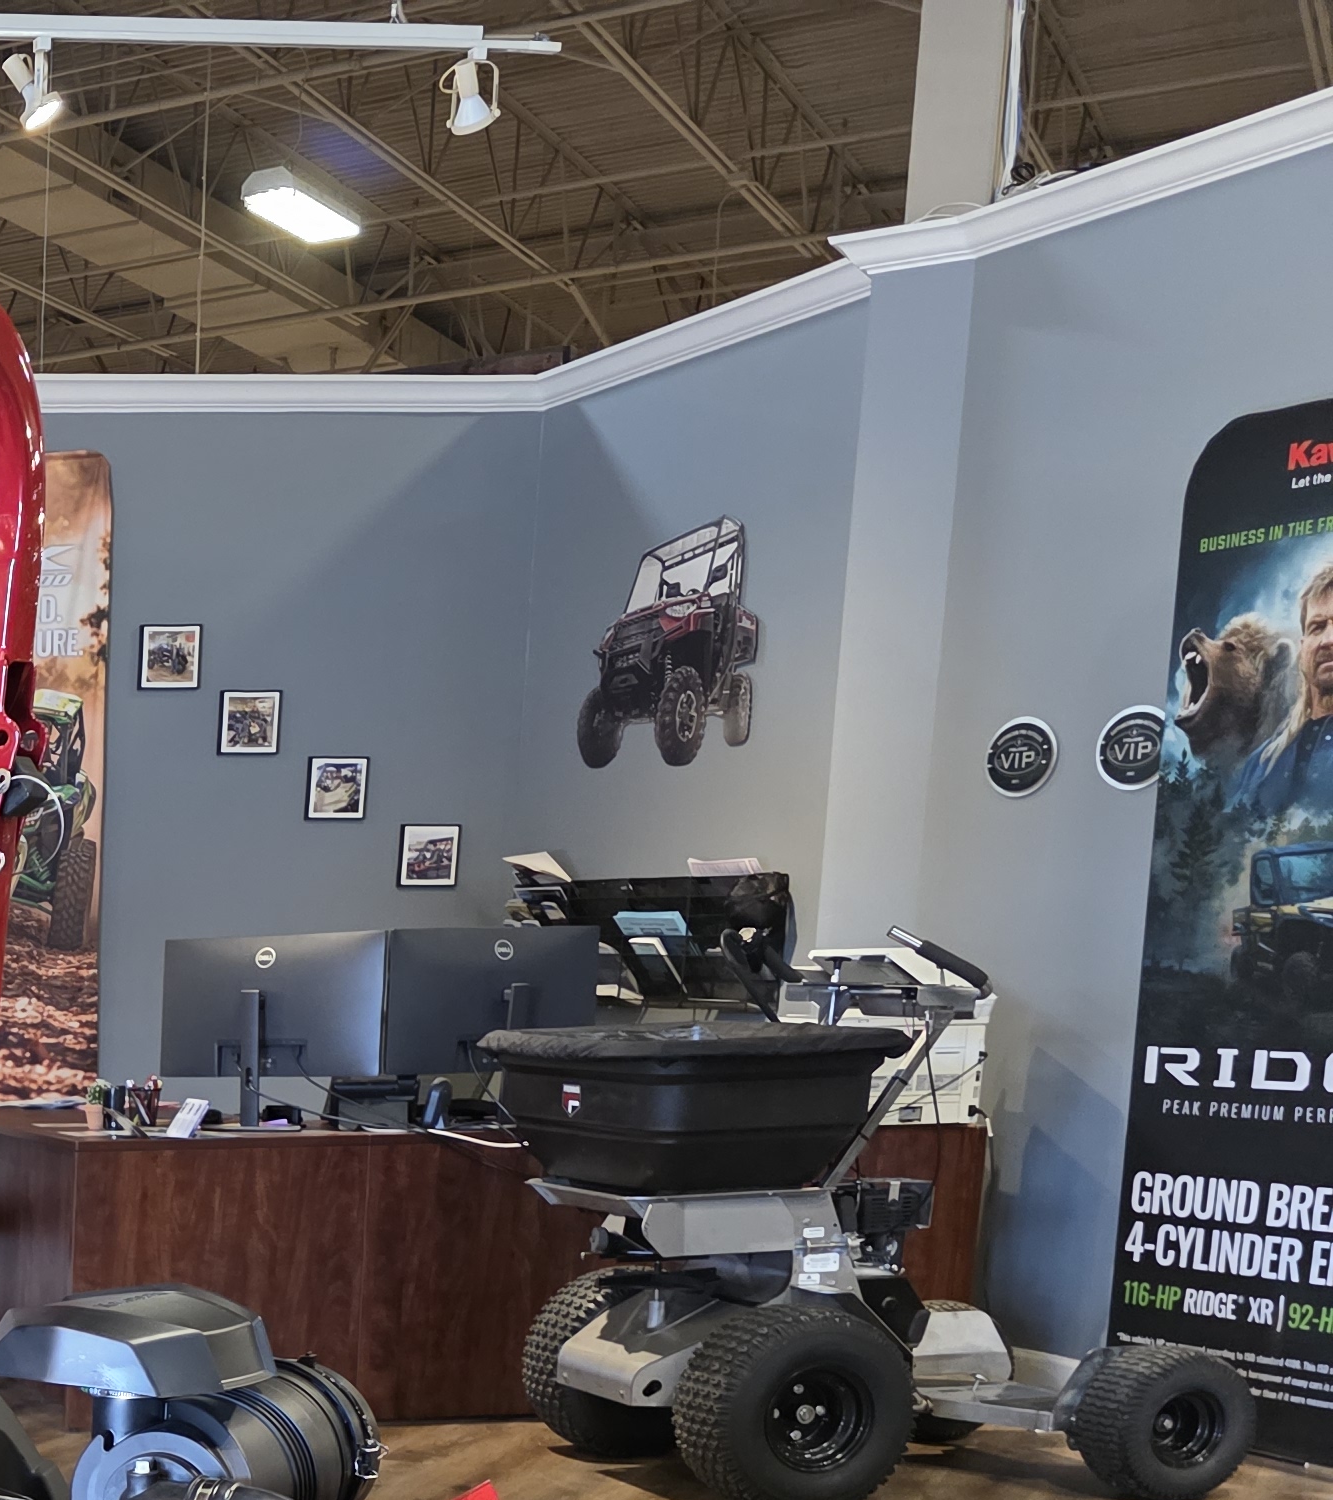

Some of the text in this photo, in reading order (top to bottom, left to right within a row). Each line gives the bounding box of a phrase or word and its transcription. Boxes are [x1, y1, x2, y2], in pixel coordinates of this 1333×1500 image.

[1291, 473, 1332, 489] Let the
[1199, 528, 1265, 553] BUSINESS
[1269, 525, 1284, 541] IN
[1288, 520, 1313, 537] THE
[1001, 751, 1035, 769] VIP
[1114, 742, 1152, 761] VIP
[1144, 1046, 1333, 1093] RID
[1162, 1099, 1201, 1117] PEAK
[1209, 1102, 1285, 1121] PREMIUM
[1131, 1171, 1333, 1232] GROUND BRE
[1124, 1220, 1304, 1284] 4-CYLINDER
[1123, 1280, 1182, 1312] 116-HP
[1247, 1296, 1275, 1325] XR
